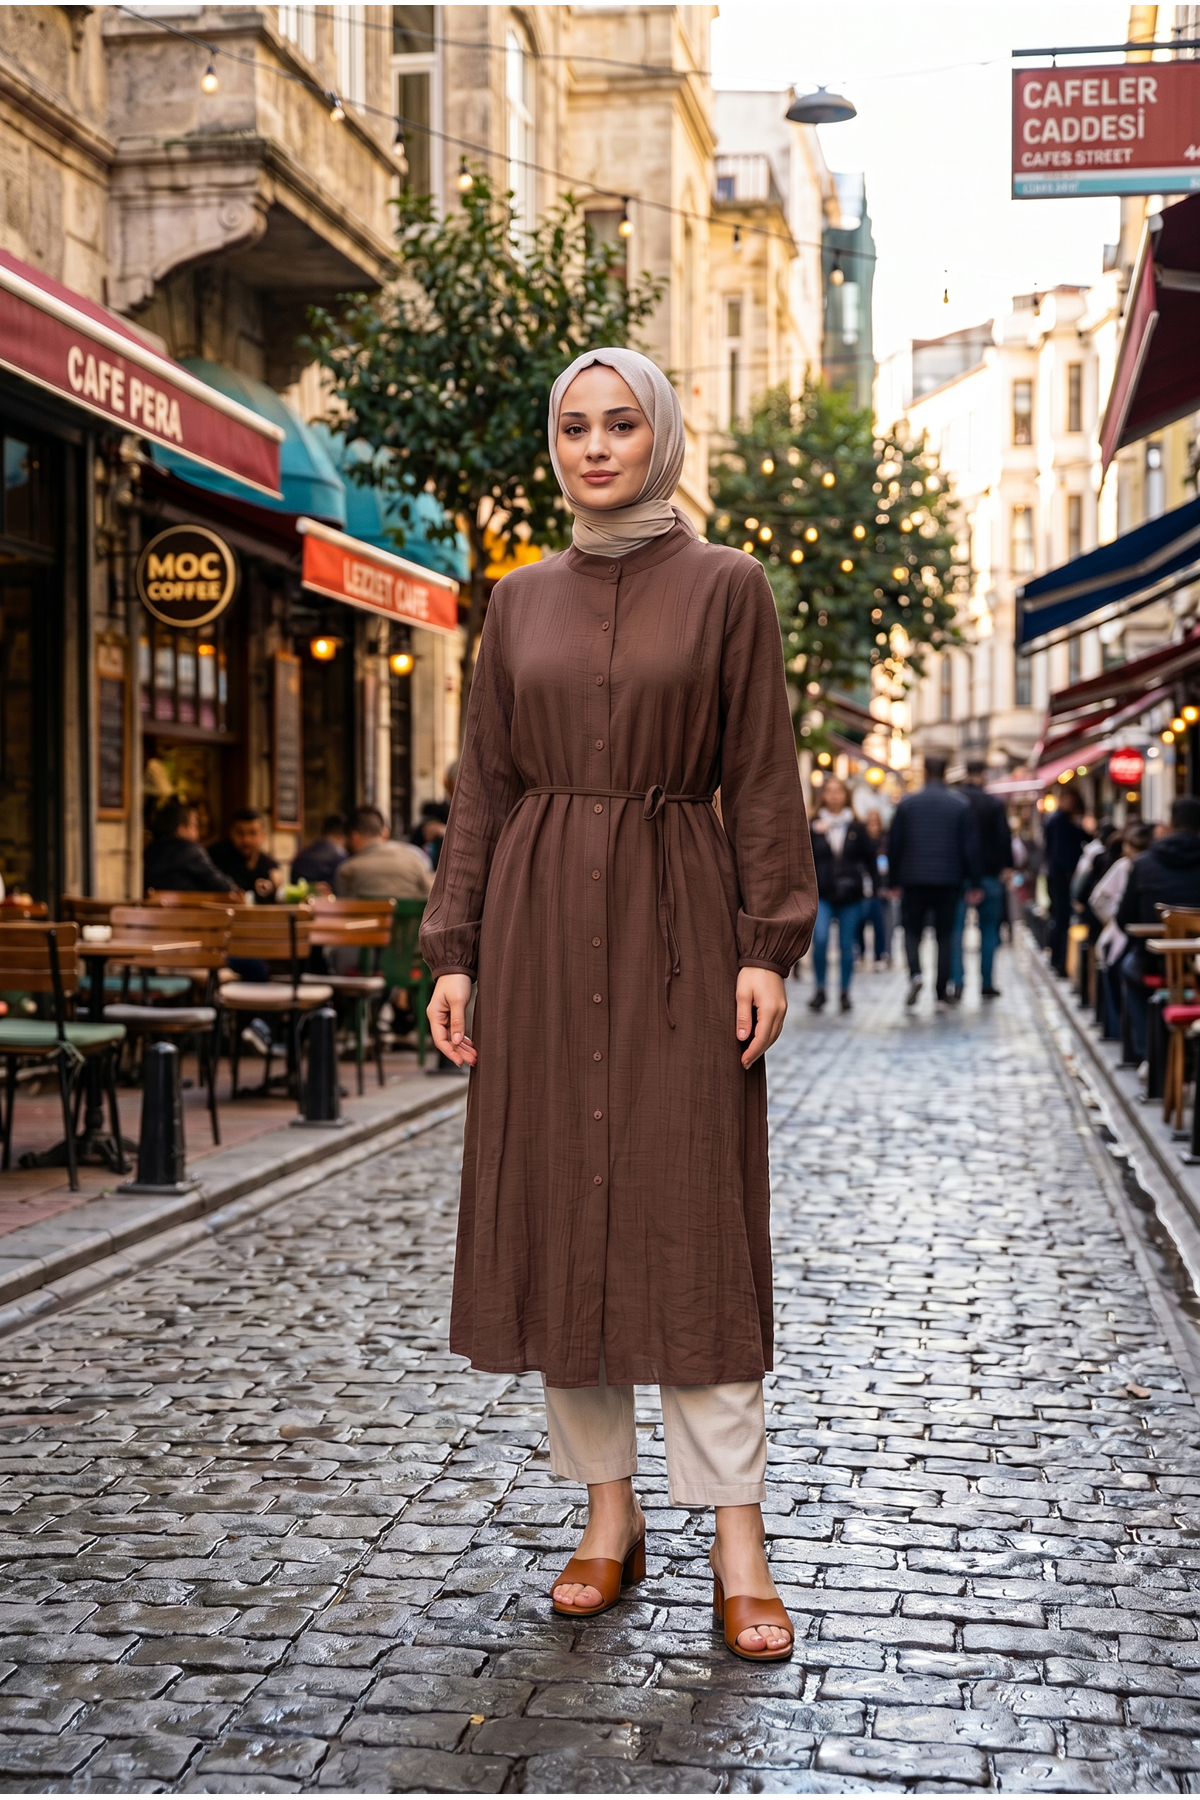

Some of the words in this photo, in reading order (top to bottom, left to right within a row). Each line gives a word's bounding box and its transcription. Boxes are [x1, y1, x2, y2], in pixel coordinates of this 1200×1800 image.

[1023, 76, 1158, 110] CAFELER
[1023, 108, 1145, 145] CADDESİ
[1021, 151, 1072, 168] CAFES
[1075, 147, 1133, 165] STREET
[130, 377, 183, 443] PERA
[148, 552, 221, 580] MOC
[147, 581, 221, 601] COFFEE
